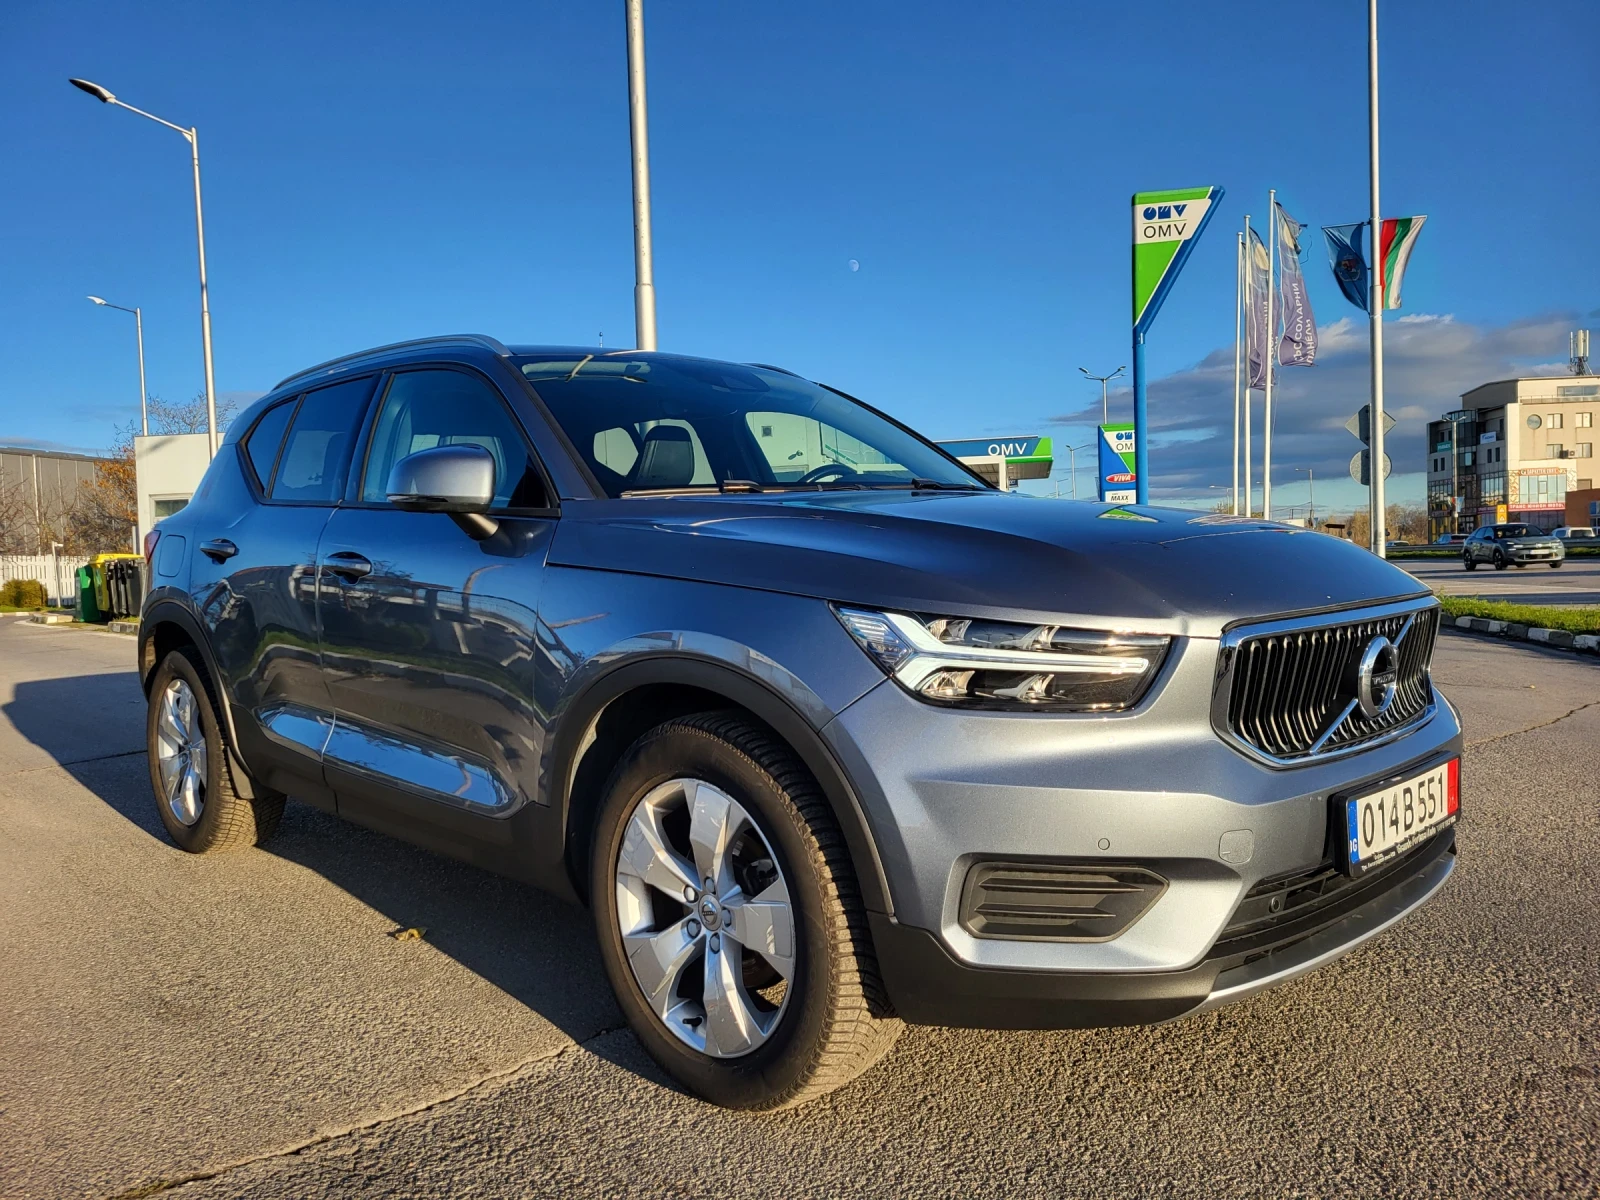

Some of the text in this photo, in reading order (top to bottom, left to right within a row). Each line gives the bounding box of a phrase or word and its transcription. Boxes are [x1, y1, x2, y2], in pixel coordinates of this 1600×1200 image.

[1143, 223, 1187, 239] OMV
[1292, 283, 1303, 340] СОЛАРНИ
[1305, 319, 1315, 364] ПАНЕЛИ
[988, 443, 1027, 456] OMV
[1116, 443, 1133, 451] OM
[1114, 474, 1131, 482] VIVA
[1363, 772, 1444, 848] 014B551
